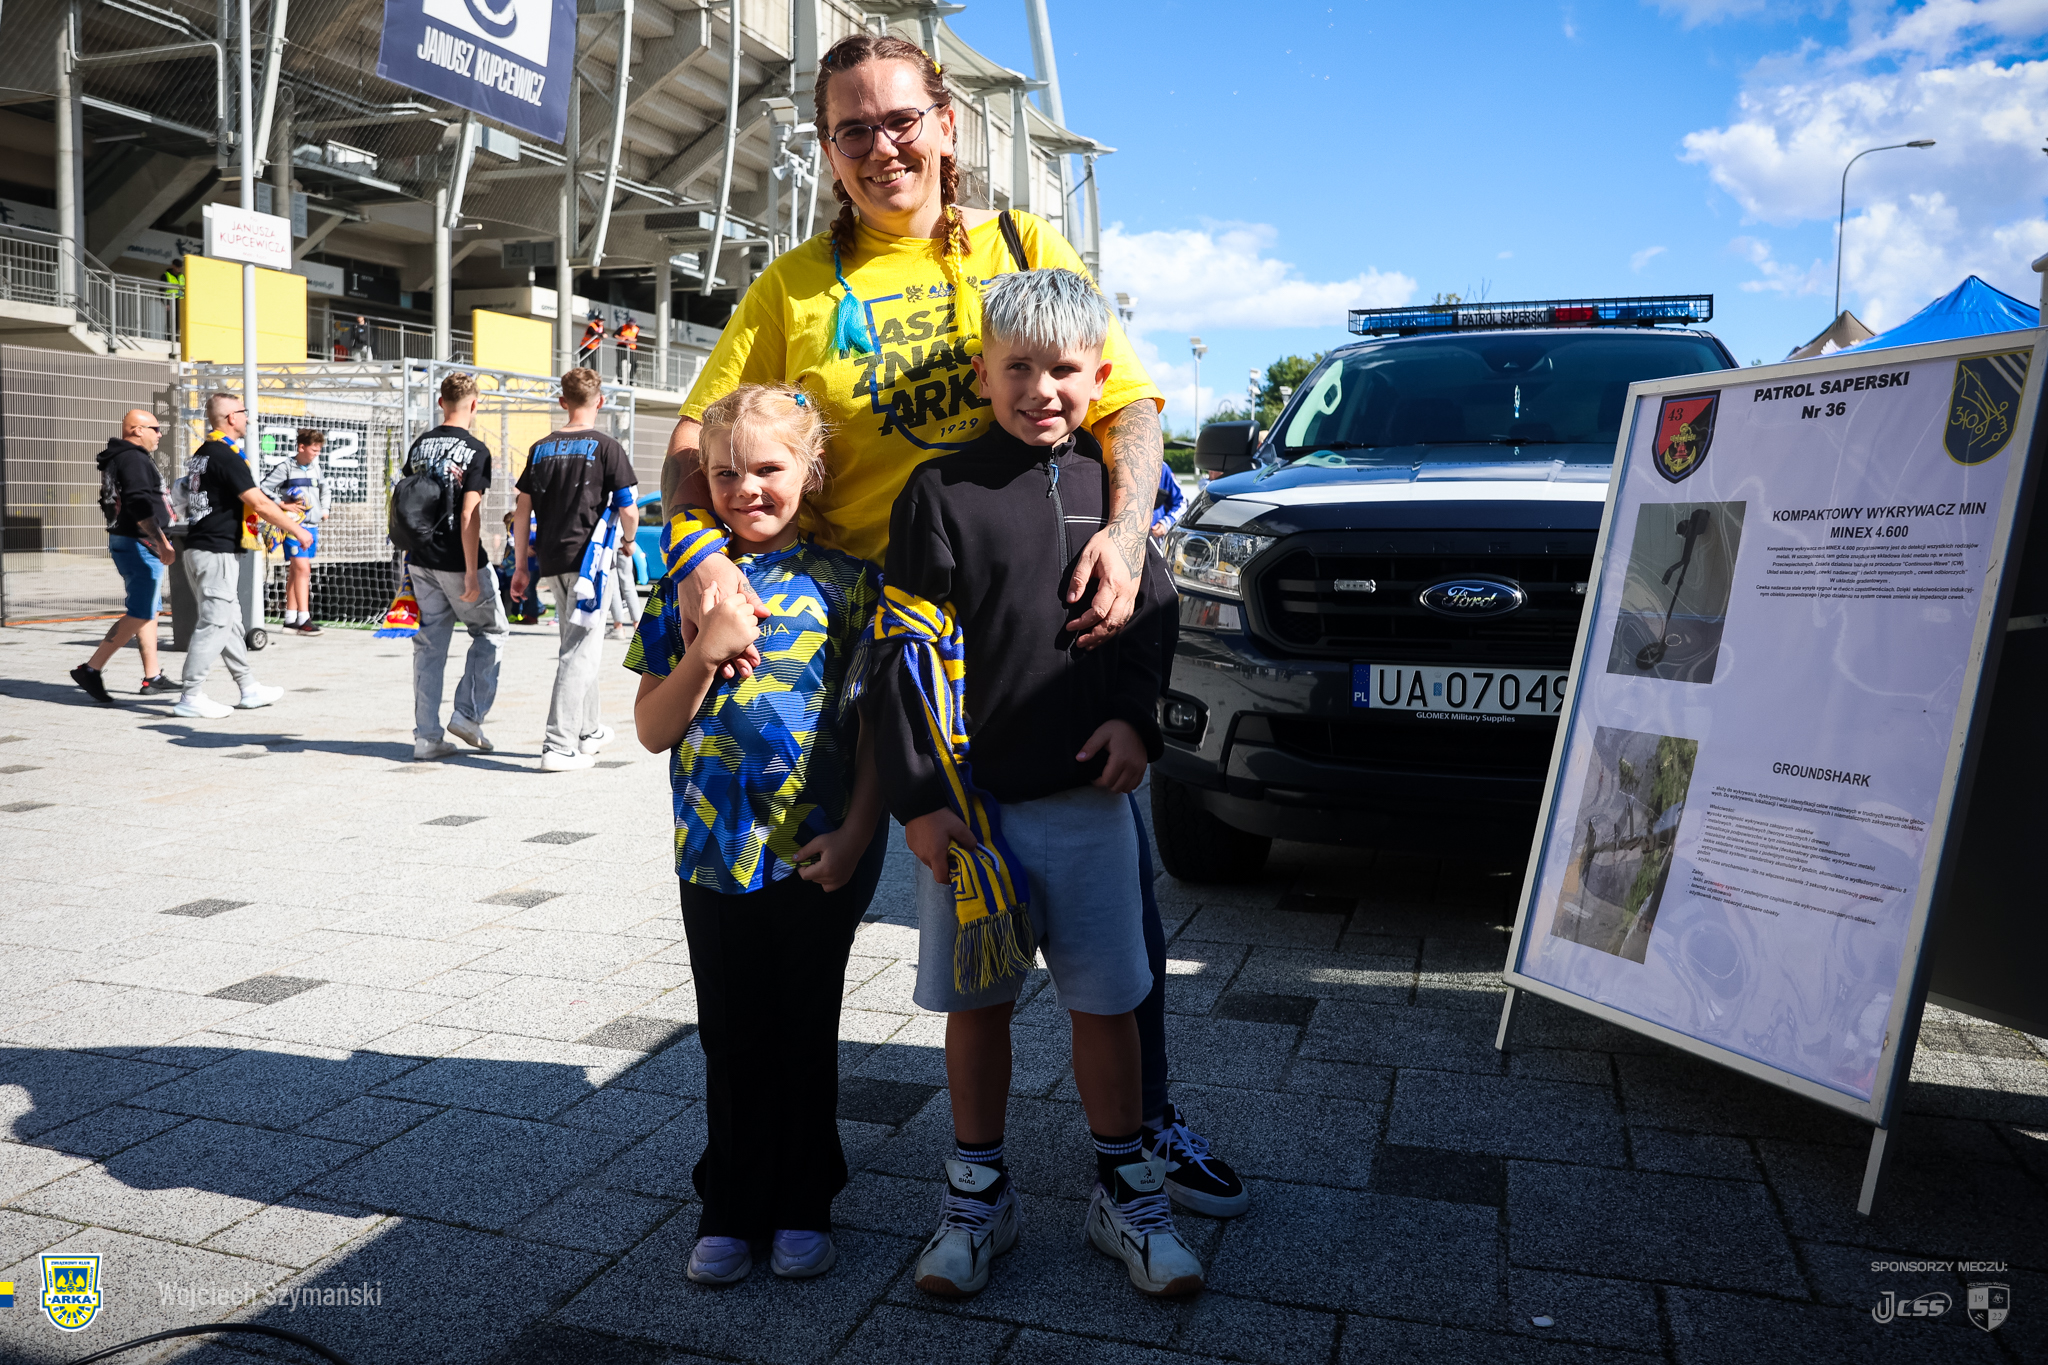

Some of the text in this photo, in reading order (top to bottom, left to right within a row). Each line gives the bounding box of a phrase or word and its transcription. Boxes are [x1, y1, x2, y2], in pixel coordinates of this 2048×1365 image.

[417, 25, 546, 107] JANUSZ KUPCEWICZ
[232, 221, 275, 237] JANUSZA
[220, 232, 286, 253] KUPCEWICZA
[1462, 311, 1546, 325] PATROL SAPERSKI
[840, 303, 959, 359] ASZ
[1754, 371, 1910, 402] PATROL SAPERSKI
[878, 368, 991, 436] ARK
[1801, 402, 1846, 419] Nr 36
[1668, 408, 1684, 421] 43
[940, 418, 979, 437] 1929
[1772, 502, 1987, 522] KOMPAKTOWY WYKRYWACZ MIN
[1830, 526, 1909, 539] MINEX 4.600
[1443, 585, 1498, 608] Ford
[763, 594, 829, 628] KA
[1354, 692, 1367, 702] PL
[1378, 669, 1569, 713] UA 07049
[1416, 712, 1516, 723] GLOMEX Military Supplies
[1772, 762, 1871, 787] GROUNDSHARK
[958, 1177, 975, 1185] SHAQ
